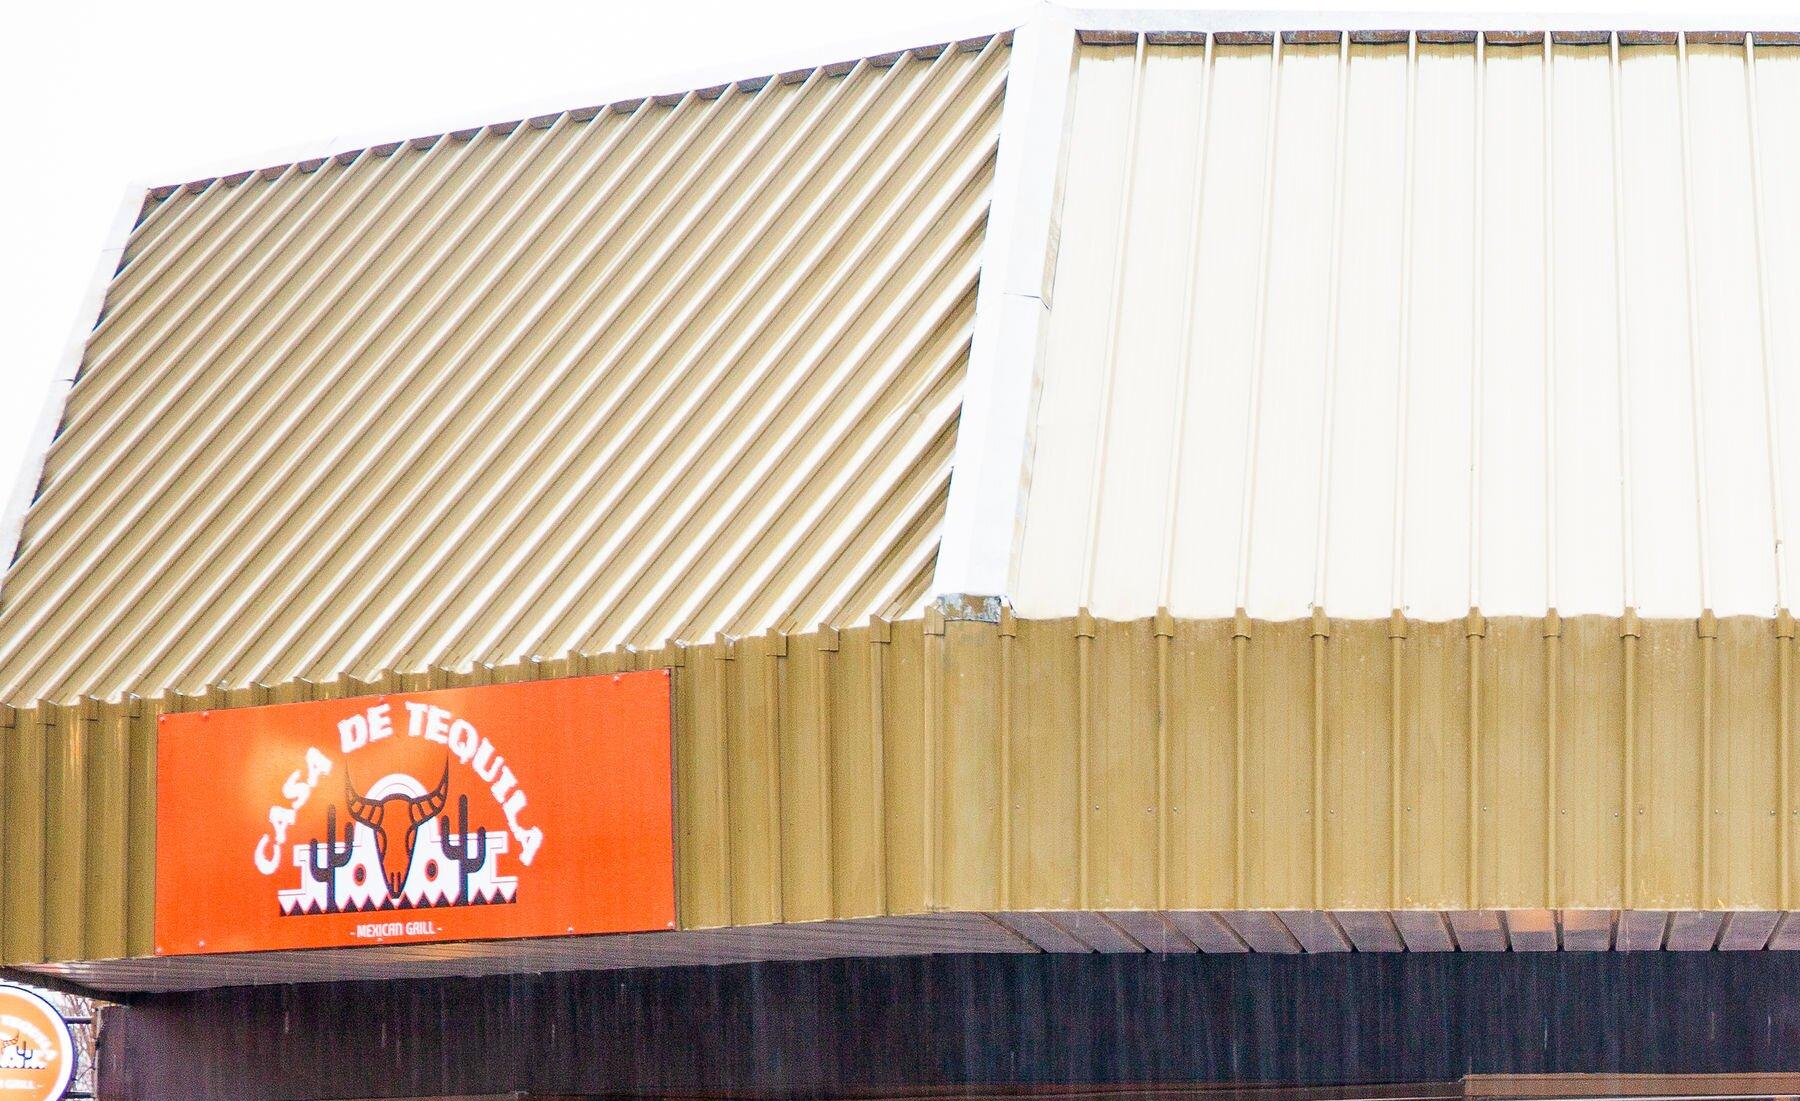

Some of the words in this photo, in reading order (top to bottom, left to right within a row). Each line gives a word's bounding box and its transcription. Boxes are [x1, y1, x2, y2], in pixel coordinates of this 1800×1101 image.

[254, 747, 332, 875] CASA
[337, 703, 393, 753] DE
[405, 701, 543, 866] TEQUILA
